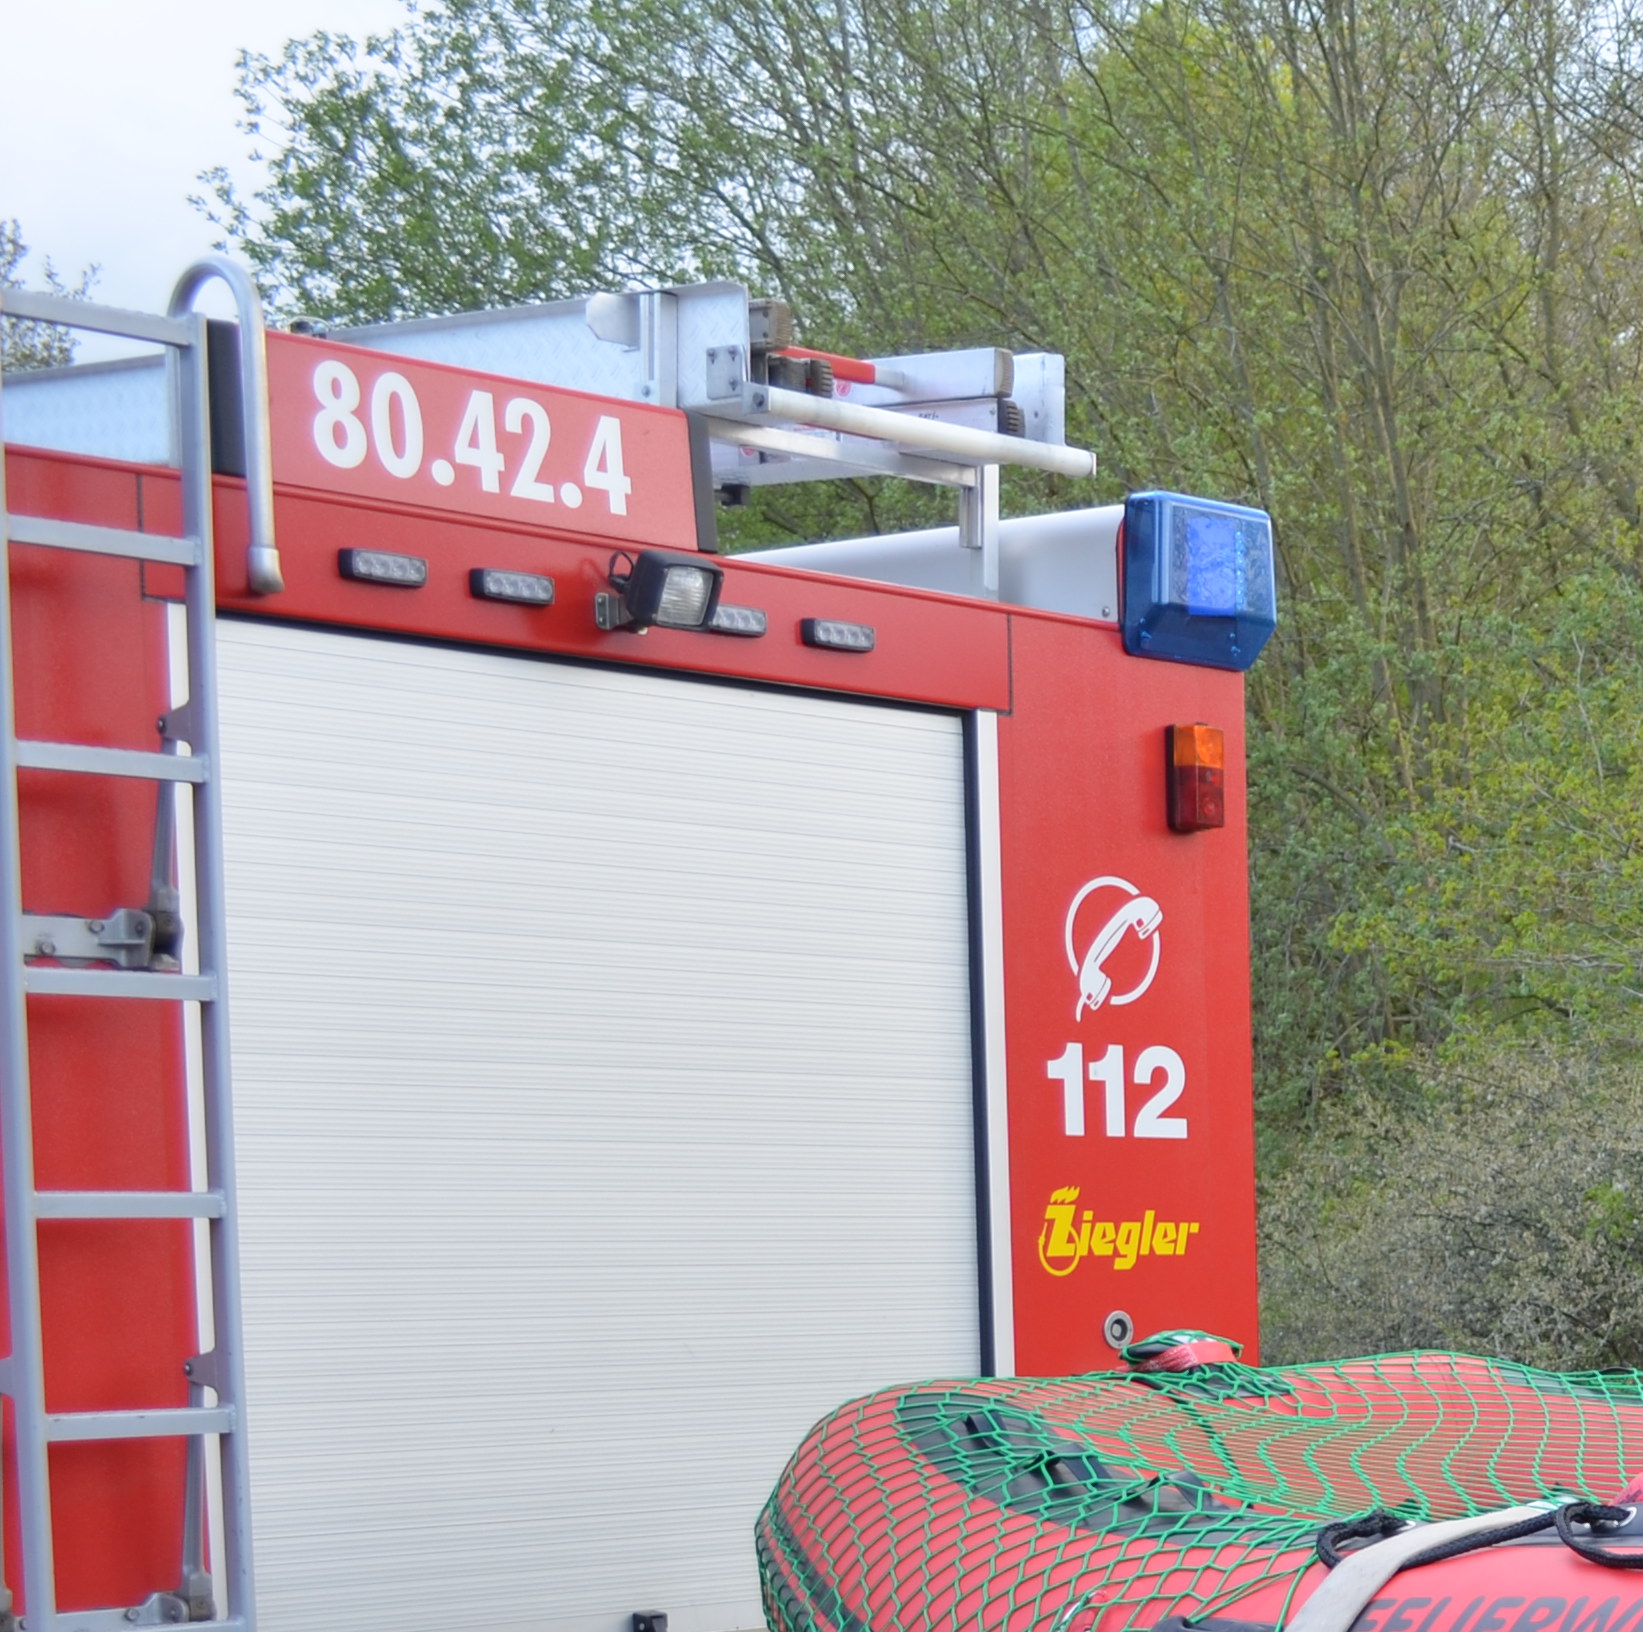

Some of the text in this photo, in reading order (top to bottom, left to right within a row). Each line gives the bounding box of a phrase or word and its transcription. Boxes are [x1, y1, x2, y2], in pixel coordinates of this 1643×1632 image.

[313, 359, 632, 516] 80.42.4
[1046, 1042, 1188, 1139] 112
[1040, 1198, 1200, 1274] Ziegler
